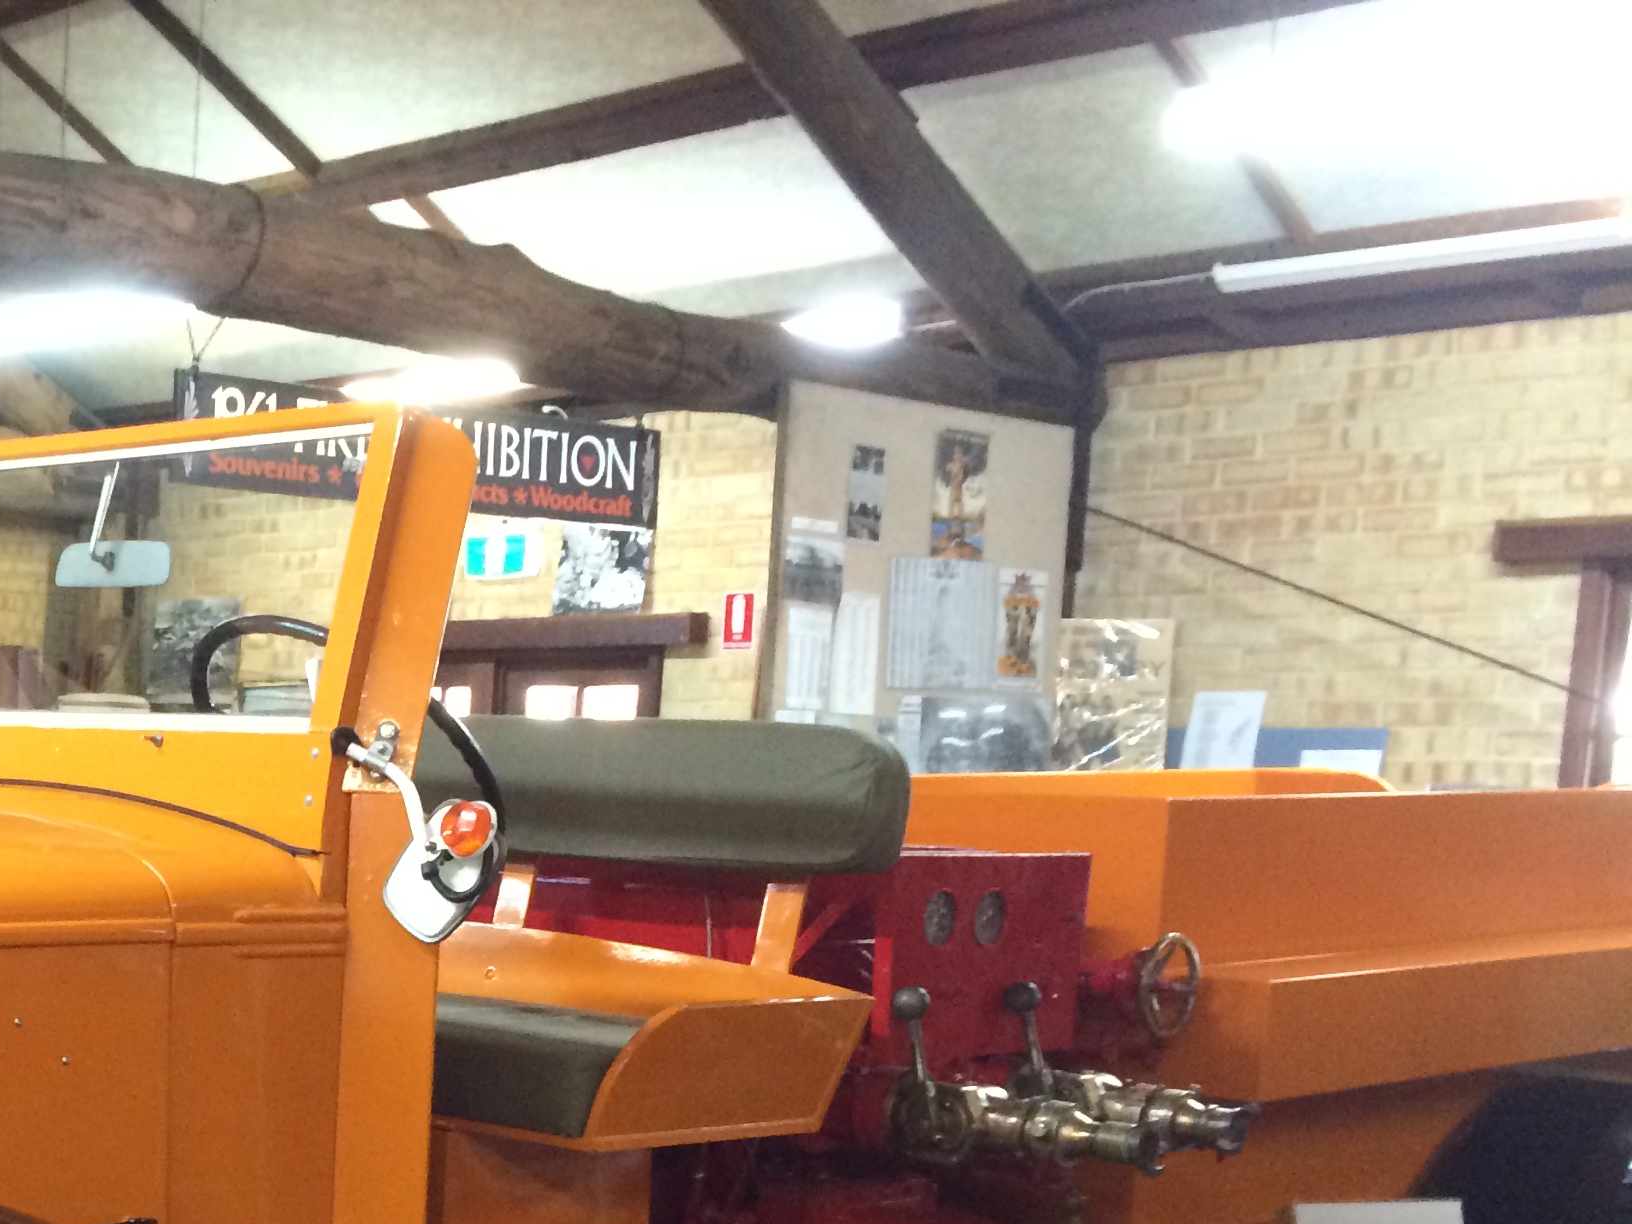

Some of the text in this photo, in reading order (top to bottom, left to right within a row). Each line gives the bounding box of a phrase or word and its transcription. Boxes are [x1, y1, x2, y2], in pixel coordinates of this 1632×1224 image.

[209, 452, 321, 484] Souvenirs
[530, 485, 632, 517] Woodcraft
[443, 416, 637, 491] HIBITION
